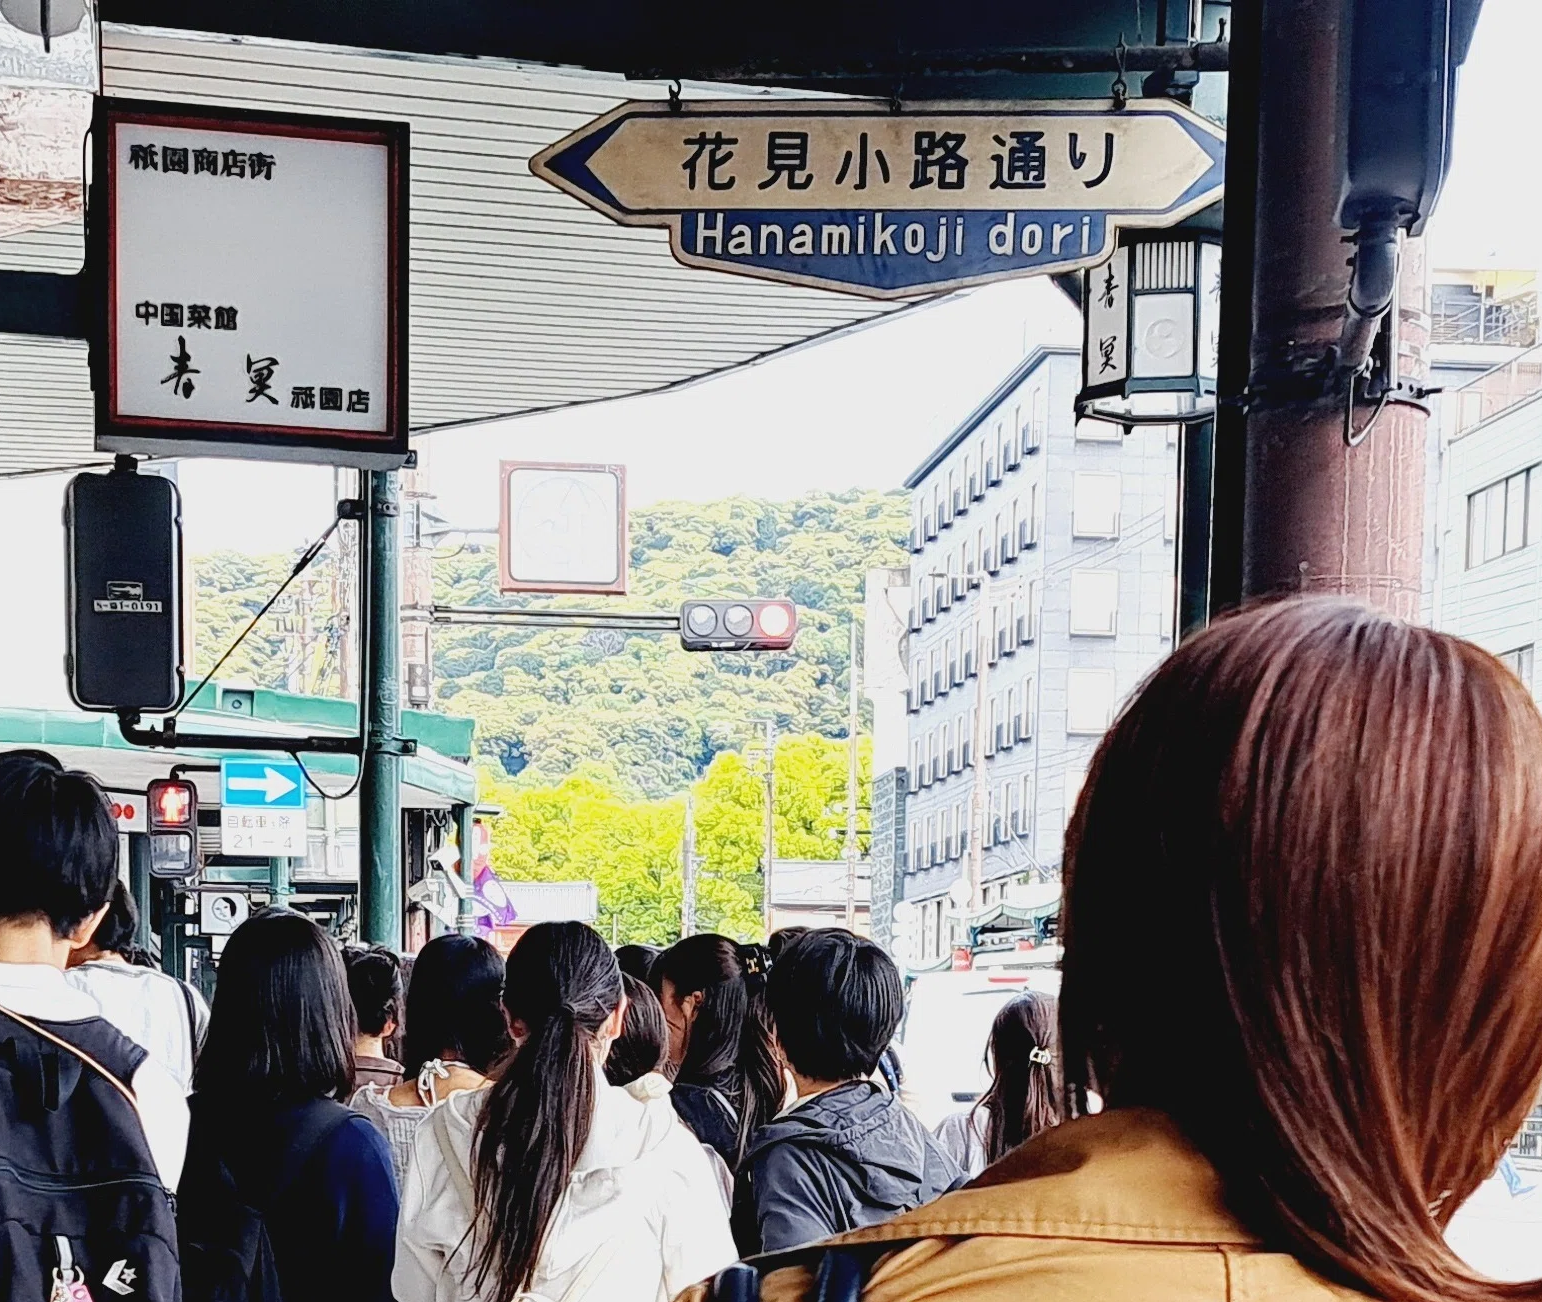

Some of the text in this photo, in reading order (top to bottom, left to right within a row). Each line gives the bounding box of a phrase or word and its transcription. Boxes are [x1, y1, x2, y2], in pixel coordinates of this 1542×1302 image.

[128, 143, 278, 182] 祇園商店街
[681, 131, 1115, 191] 花見小路通り
[695, 212, 1092, 264] Hanamikoji dori
[135, 301, 239, 332] 中国菜館
[290, 387, 371, 414] 祇園店
